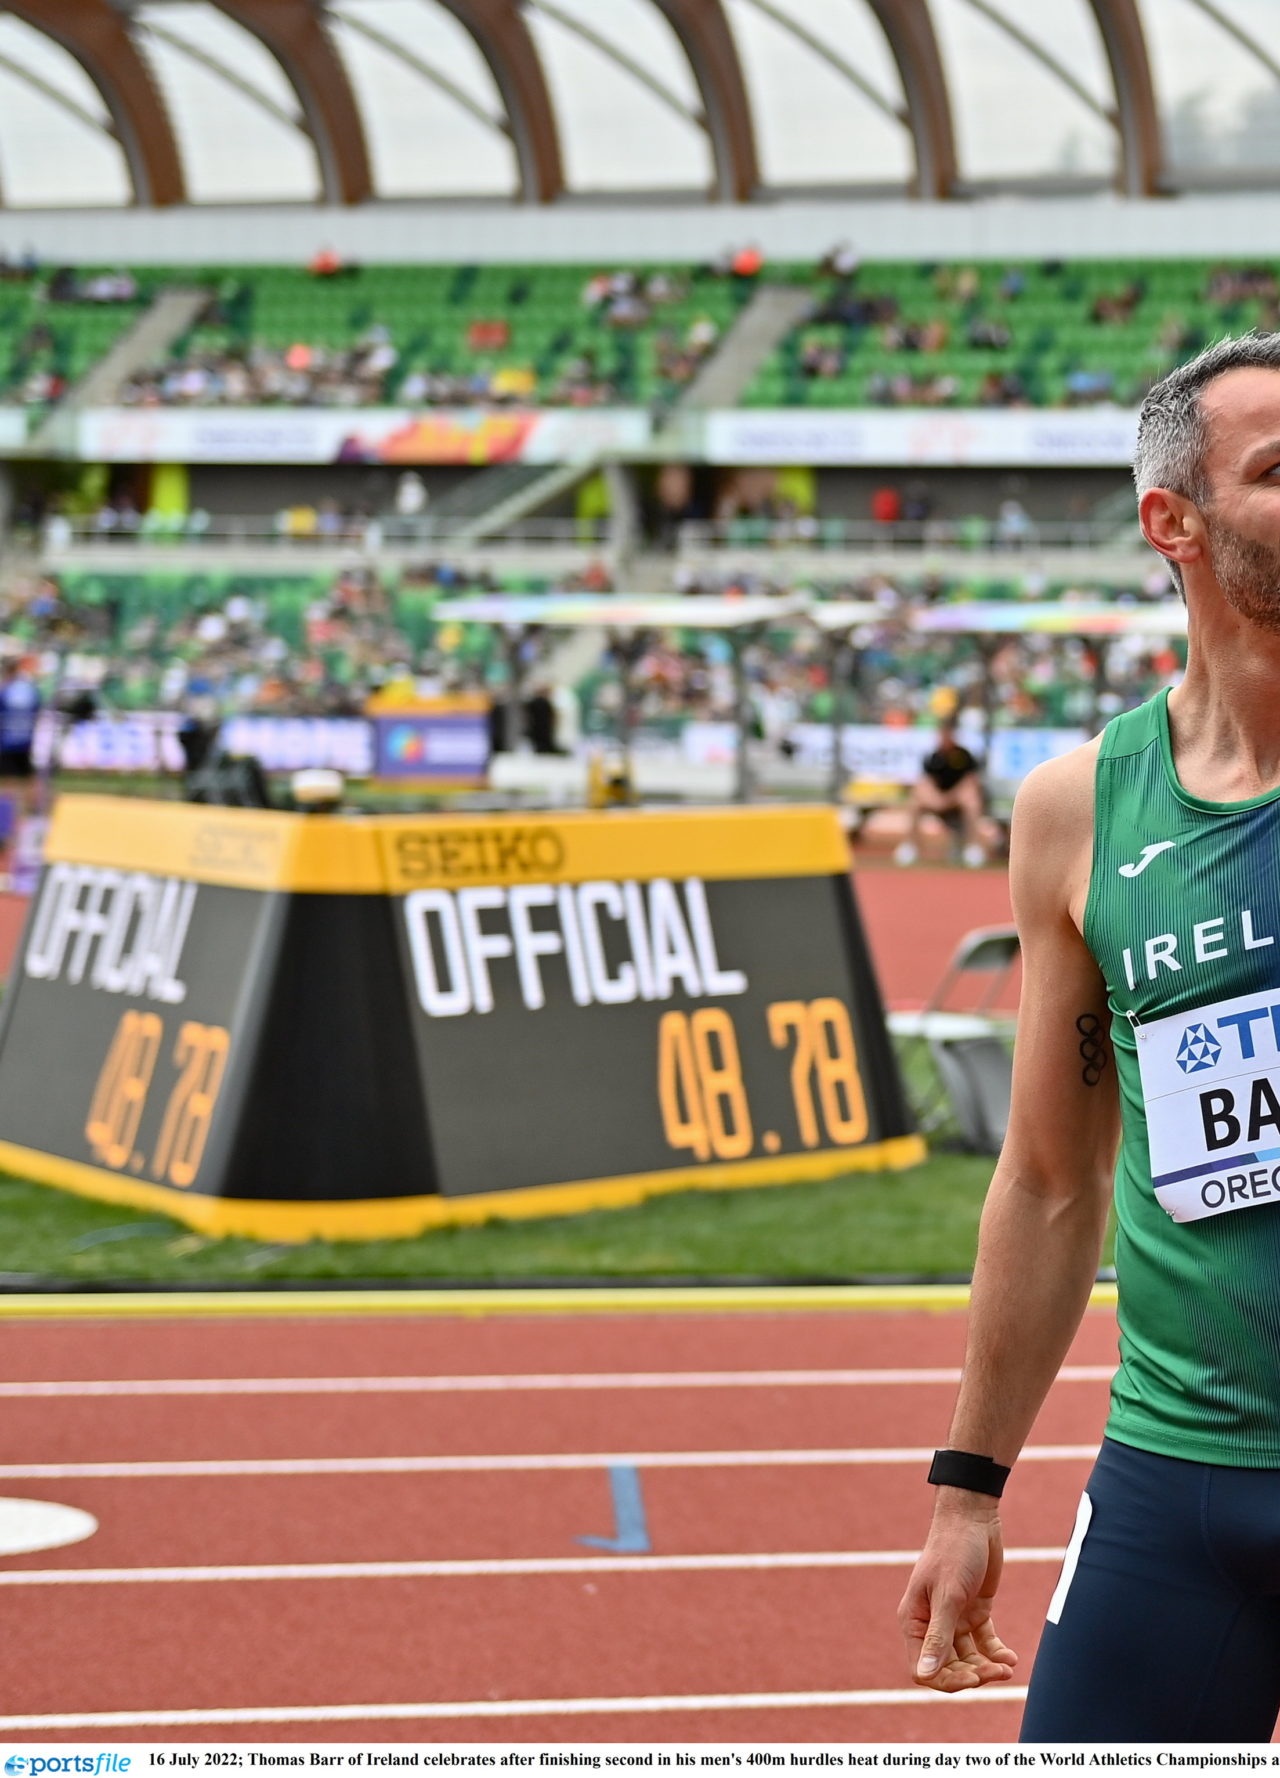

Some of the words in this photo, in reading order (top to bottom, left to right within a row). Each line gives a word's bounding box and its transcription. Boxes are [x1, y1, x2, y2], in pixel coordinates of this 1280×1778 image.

[396, 828, 567, 880] SEIKO
[404, 877, 748, 1018] OFFICIAL
[658, 998, 870, 1162] 48.78
